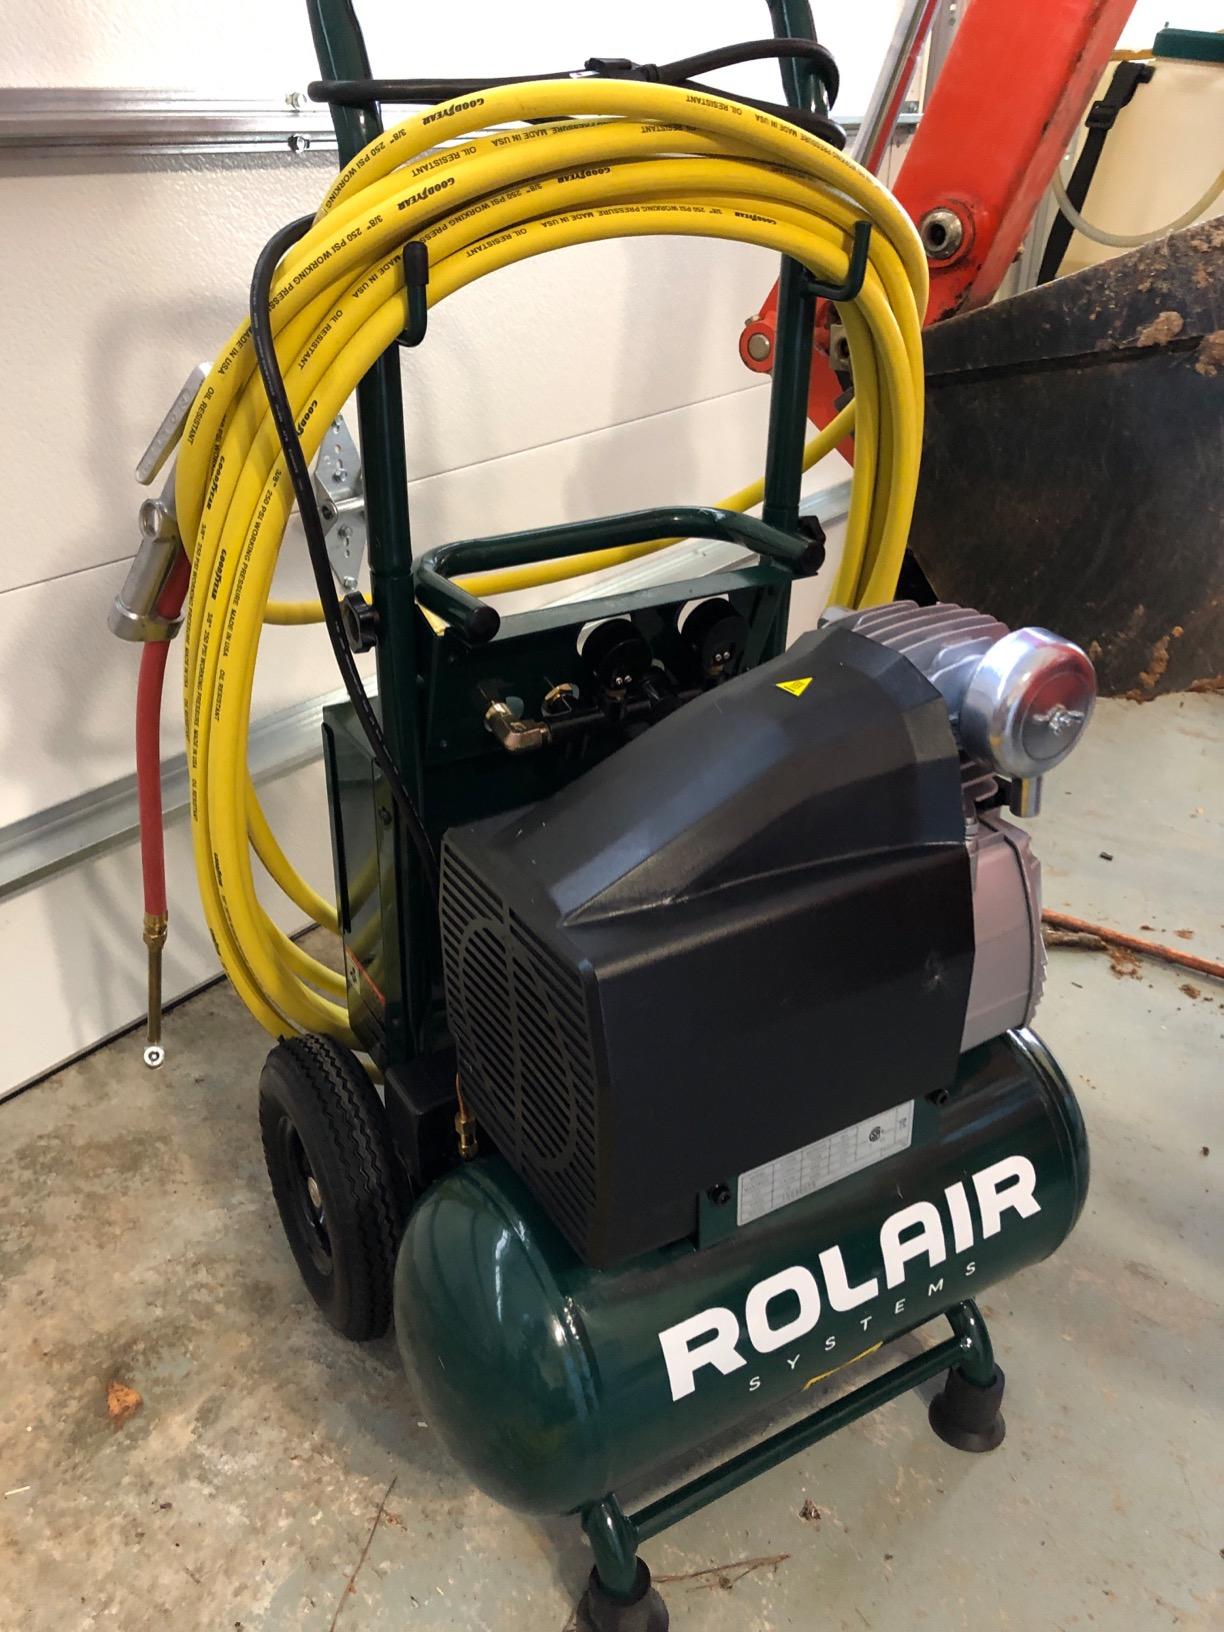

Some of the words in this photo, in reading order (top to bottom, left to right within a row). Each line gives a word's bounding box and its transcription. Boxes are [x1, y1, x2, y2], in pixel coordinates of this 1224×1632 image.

[422, 98, 484, 125] GOODYEAR
[686, 95, 729, 112] RESISTANT
[729, 105, 743, 115] OIL
[754, 113, 768, 123] USA
[511, 134, 522, 142] IN
[522, 128, 548, 140] MADE
[779, 124, 798, 137] MADE
[370, 141, 386, 157] 250
[491, 136, 510, 146] USA
[460, 146, 477, 156] OIL
[355, 153, 371, 169] PSI
[412, 152, 461, 177] RESISTANT
[558, 167, 611, 183] GOODYEAR
[326, 167, 357, 209] WORKING
[397, 177, 455, 210] GOODYEAR
[506, 190, 522, 200] 250
[490, 196, 506, 206] PSI
[448, 203, 491, 226] WORKING
[571, 211, 594, 221] MADE
[597, 206, 640, 217] PRESSURE
[541, 219, 558, 228] USA
[559, 216, 570, 224] IN
[346, 227, 363, 242] 250
[419, 223, 448, 243] PRESS
[512, 228, 527, 237] OIL
[331, 238, 347, 253] PSI
[466, 233, 512, 258] RESISTANT
[293, 250, 332, 285] WORKING
[377, 255, 401, 276] MADE
[368, 273, 379, 284] IN
[268, 282, 294, 311] PRESS
[352, 282, 370, 298] USA
[329, 310, 343, 323] OIL
[229, 347, 238, 358] IN
[298, 323, 332, 370] RESISTANT
[217, 357, 232, 374] USA
[203, 386, 215, 400] OIL
[187, 400, 207, 446] RESISTANT
[206, 456, 225, 510] GOODYEAR
[263, 489, 273, 505] 250
[257, 504, 267, 521] PSI
[244, 521, 261, 561] WORKING
[211, 549, 227, 600] GOODYEAR
[233, 562, 248, 606] PRESSURE
[227, 608, 237, 632] MADE
[222, 640, 230, 657] USA
[214, 682, 224, 721] RESISTANT
[658, 1155, 1041, 1402] ROLAIR
[748, 1262, 976, 1391] SYSTEMS
